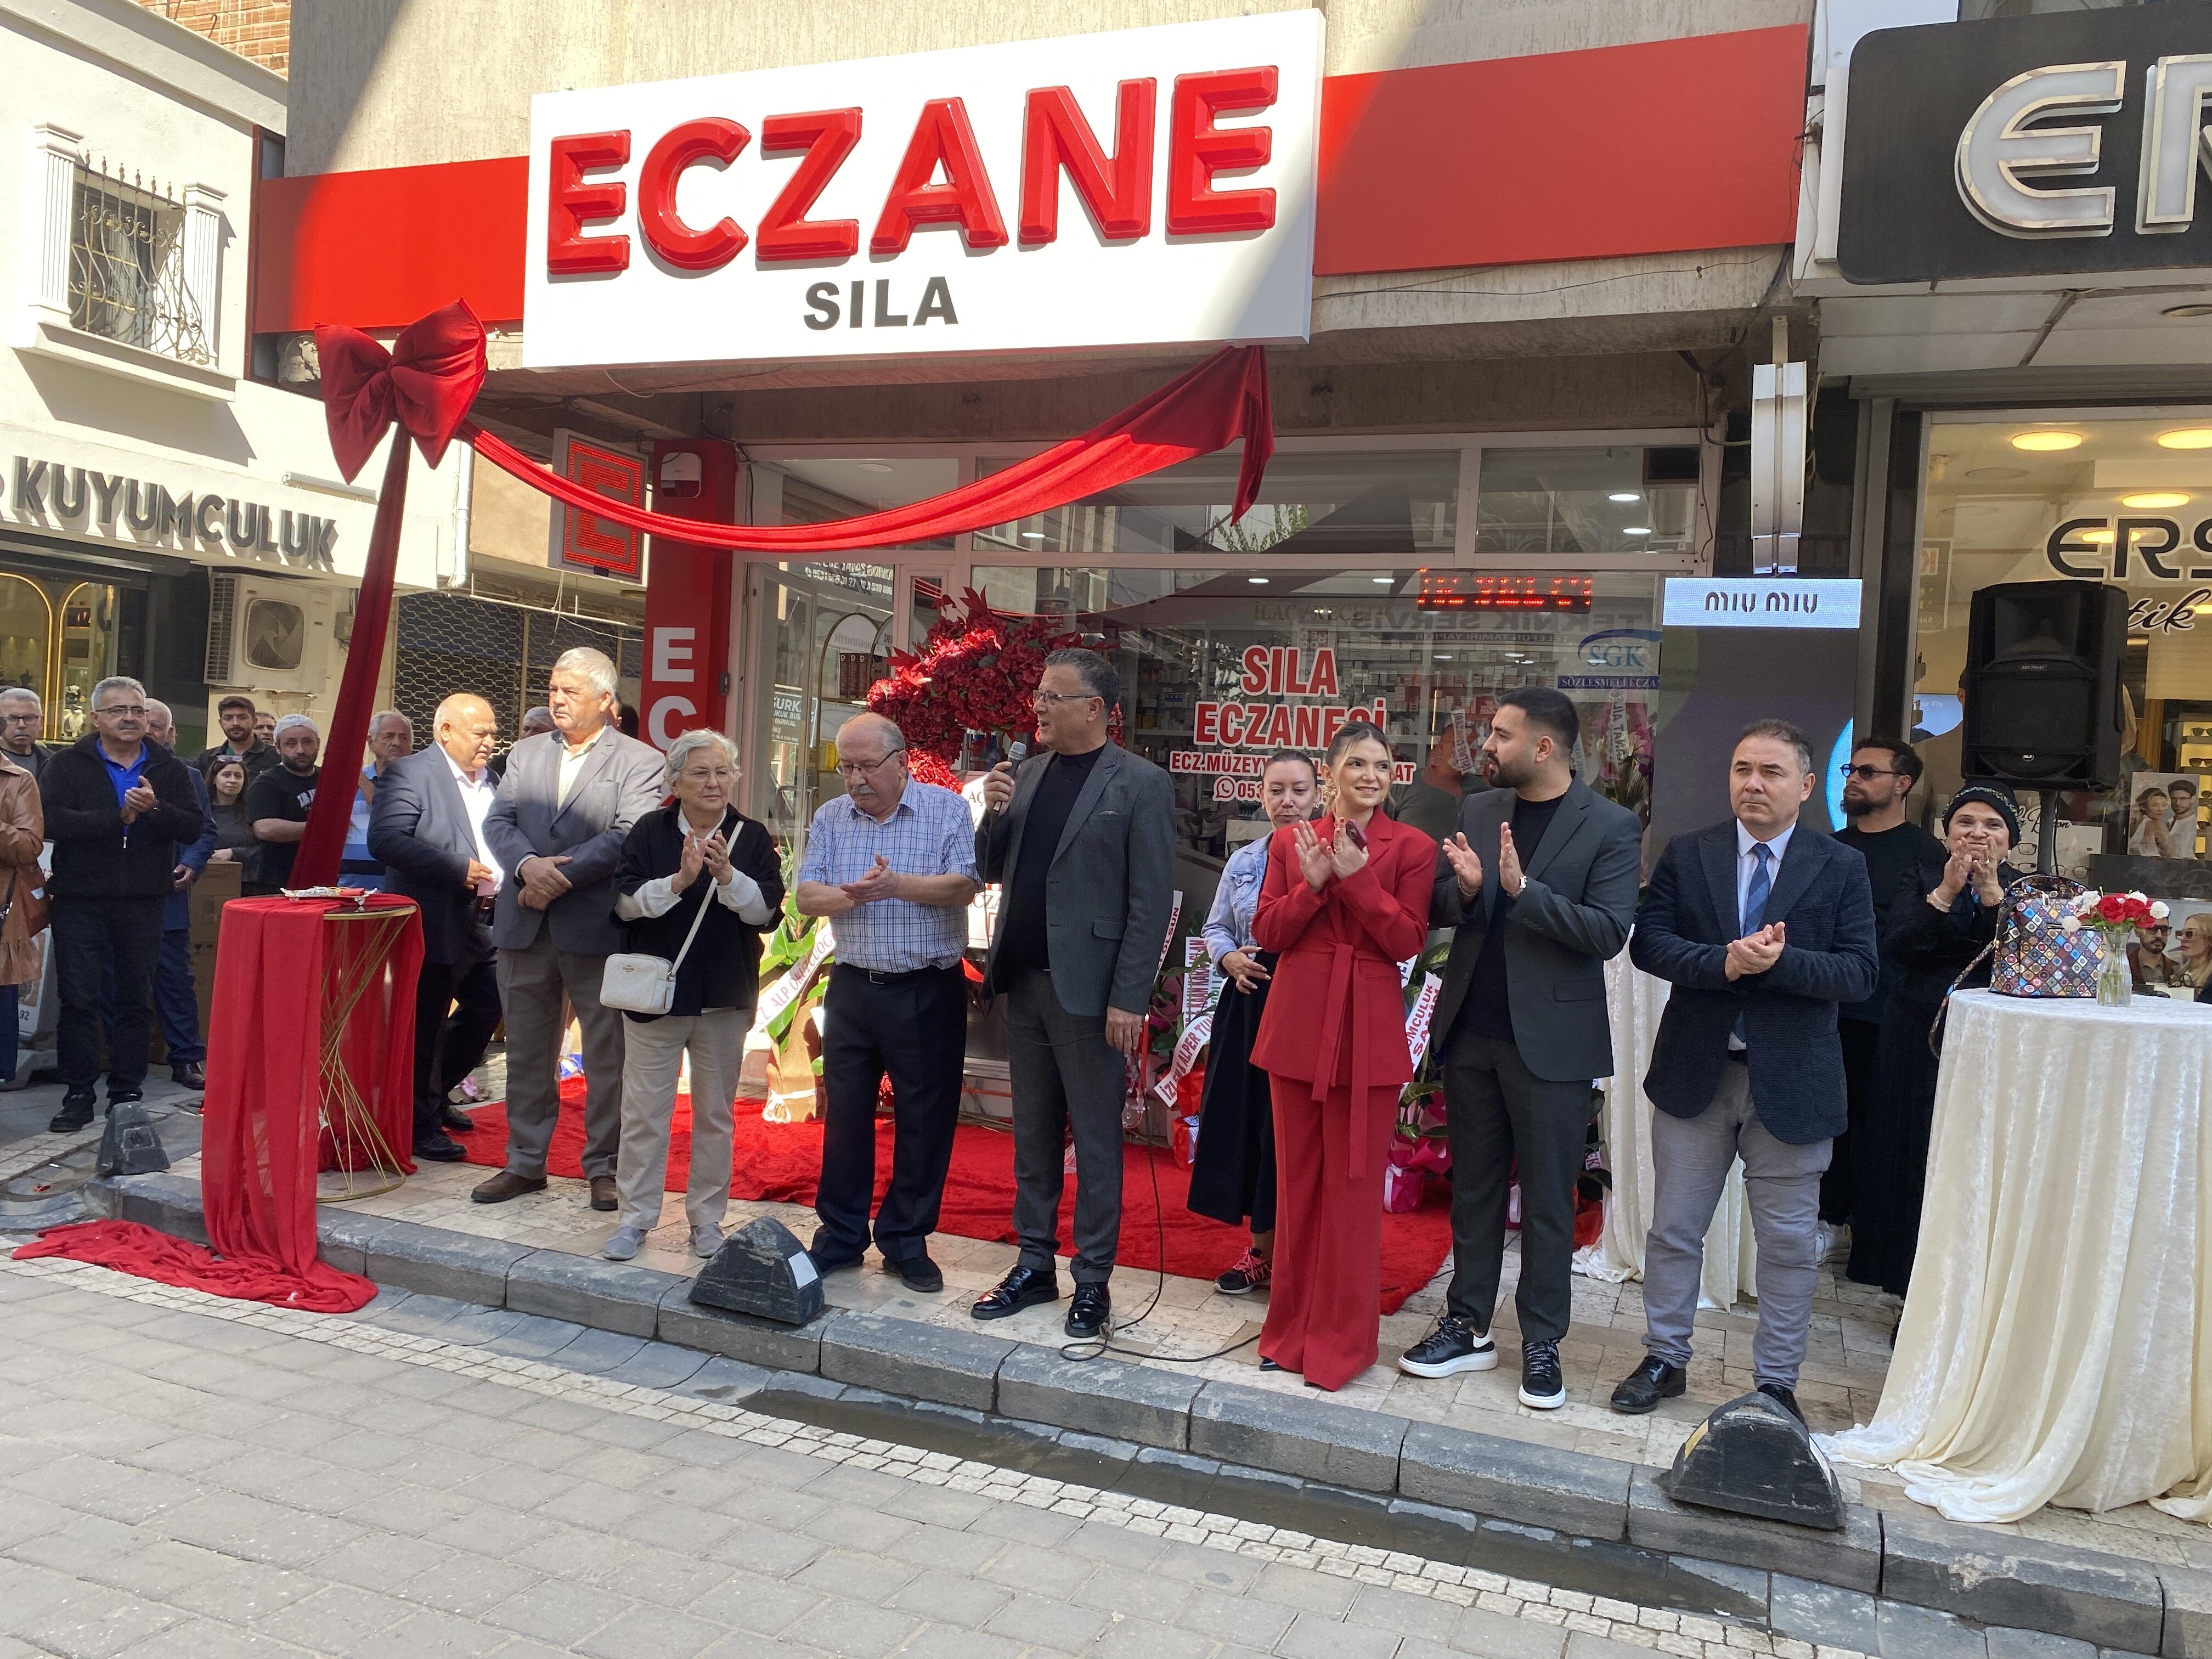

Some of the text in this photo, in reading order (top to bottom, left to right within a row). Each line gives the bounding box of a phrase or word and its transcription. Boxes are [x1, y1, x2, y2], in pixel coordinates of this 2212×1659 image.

[548, 65, 1279, 275] ECZANE
[803, 276, 959, 330] SILA
[10, 455, 338, 563] KUYUMCULUK
[884, 634, 893, 644] DE
[1588, 645, 1644, 667] SGK
[1243, 647, 1338, 695] SILA
[1562, 676, 1626, 688] SÖZLEŞMELİ
[1161, 907, 1179, 954] OLSUN
[1178, 1032, 1201, 1068] ALPER
